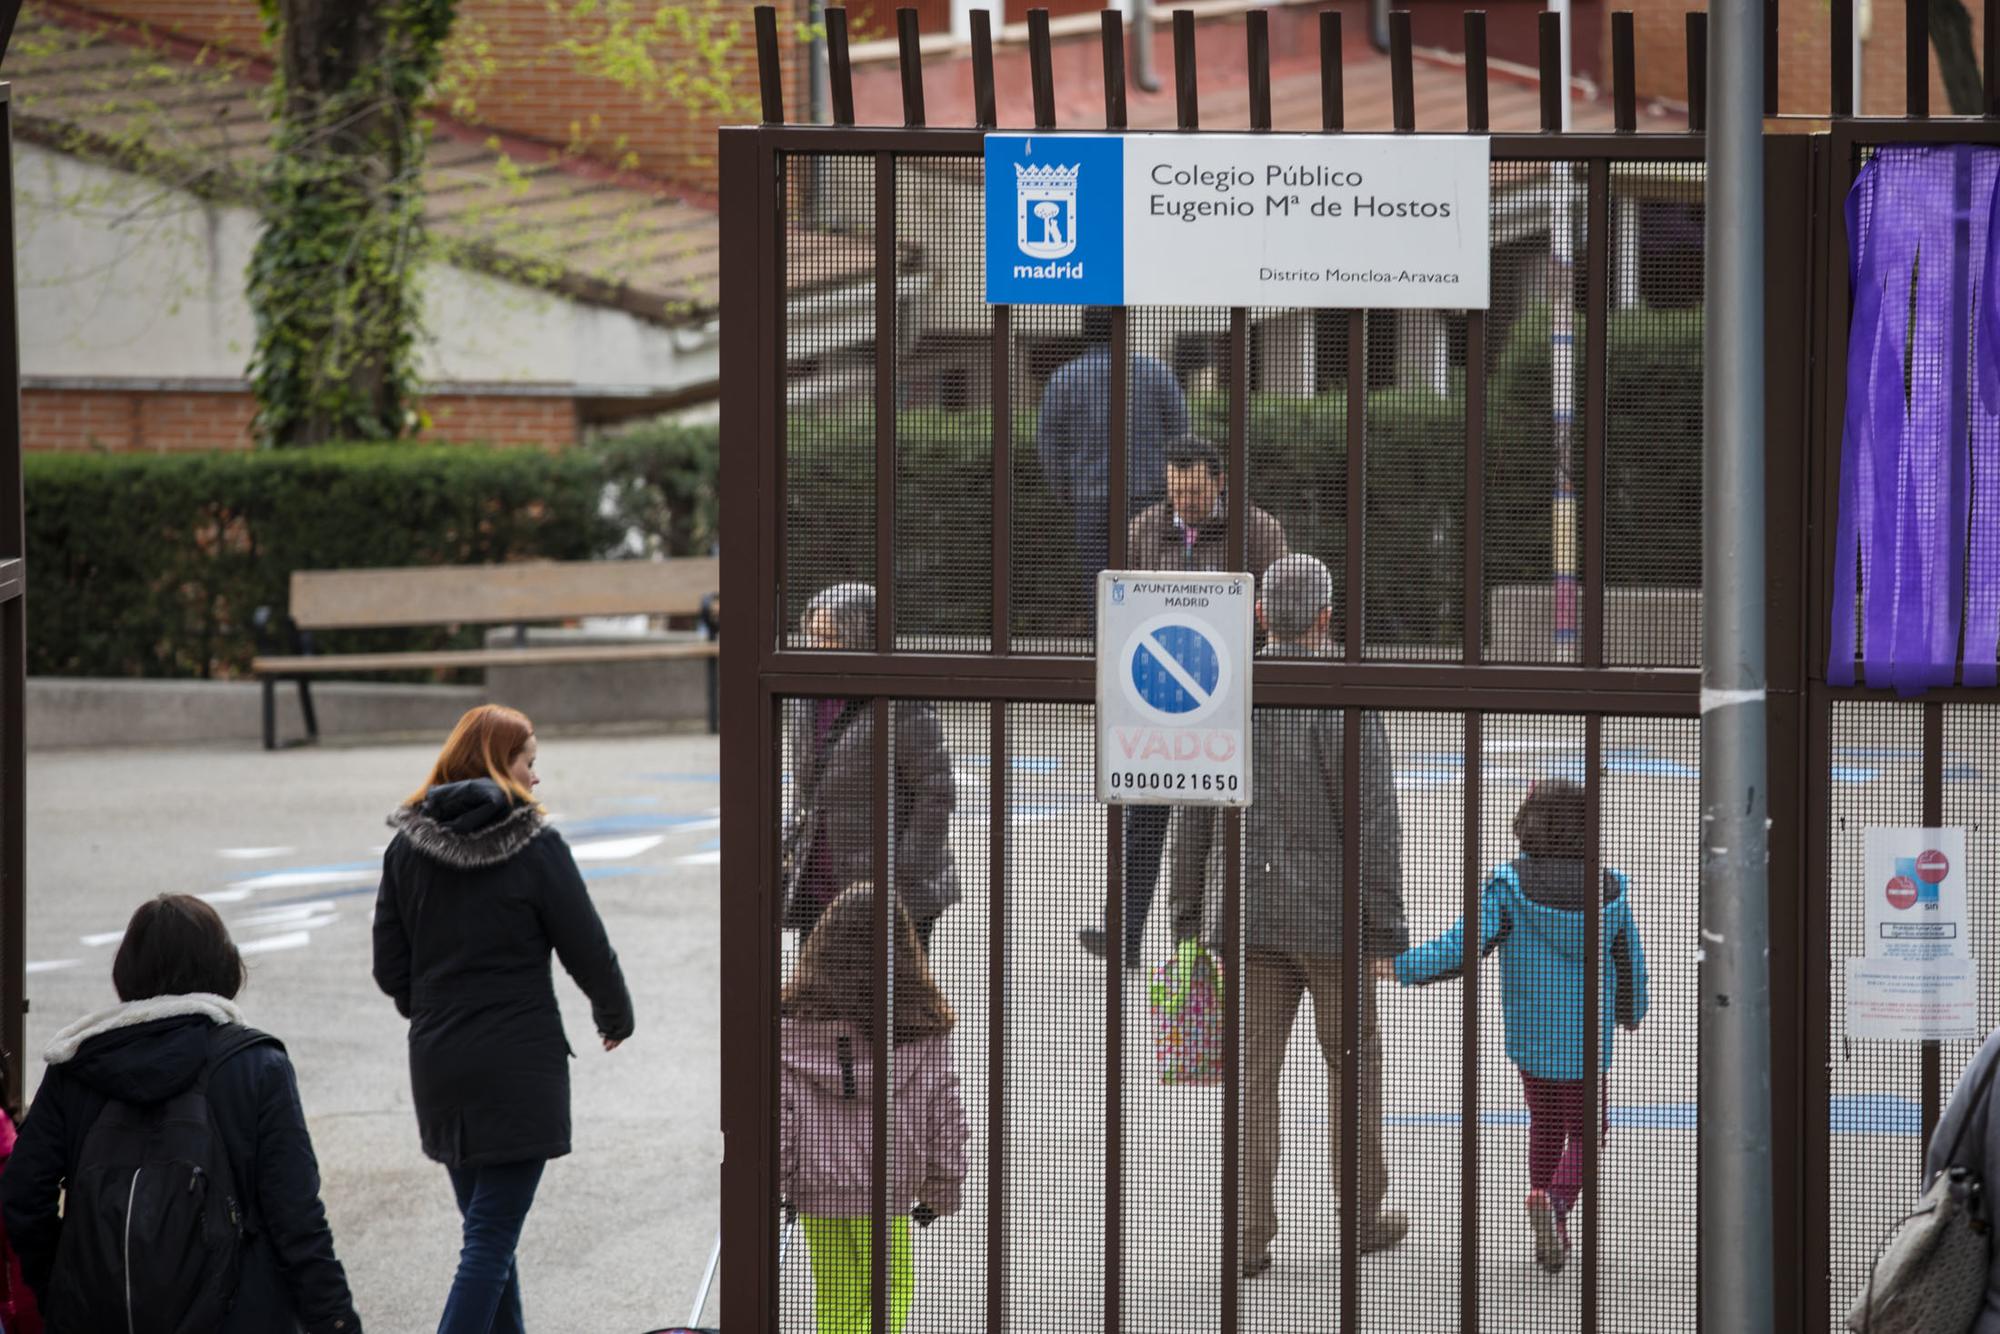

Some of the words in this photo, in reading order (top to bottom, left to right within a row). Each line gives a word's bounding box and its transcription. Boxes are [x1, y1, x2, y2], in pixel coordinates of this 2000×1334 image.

[1151, 164, 1254, 192] Colegio
[1266, 165, 1363, 187] Público
[1150, 195, 1254, 222] Eugenio
[1266, 195, 1299, 217] Mª
[1310, 196, 1342, 217] de
[1354, 196, 1451, 217] Hostos
[1013, 262, 1084, 279] madrid
[1259, 268, 1320, 282] Distrito
[1326, 269, 1460, 283] Moncloa-Aravaca
[1132, 583, 1224, 595] AYUNTAMIENTO
[1228, 585, 1243, 595] DE
[1164, 597, 1210, 608] MADRID
[1115, 728, 1236, 763] VADO
[1111, 772, 1238, 791] 0900021650
